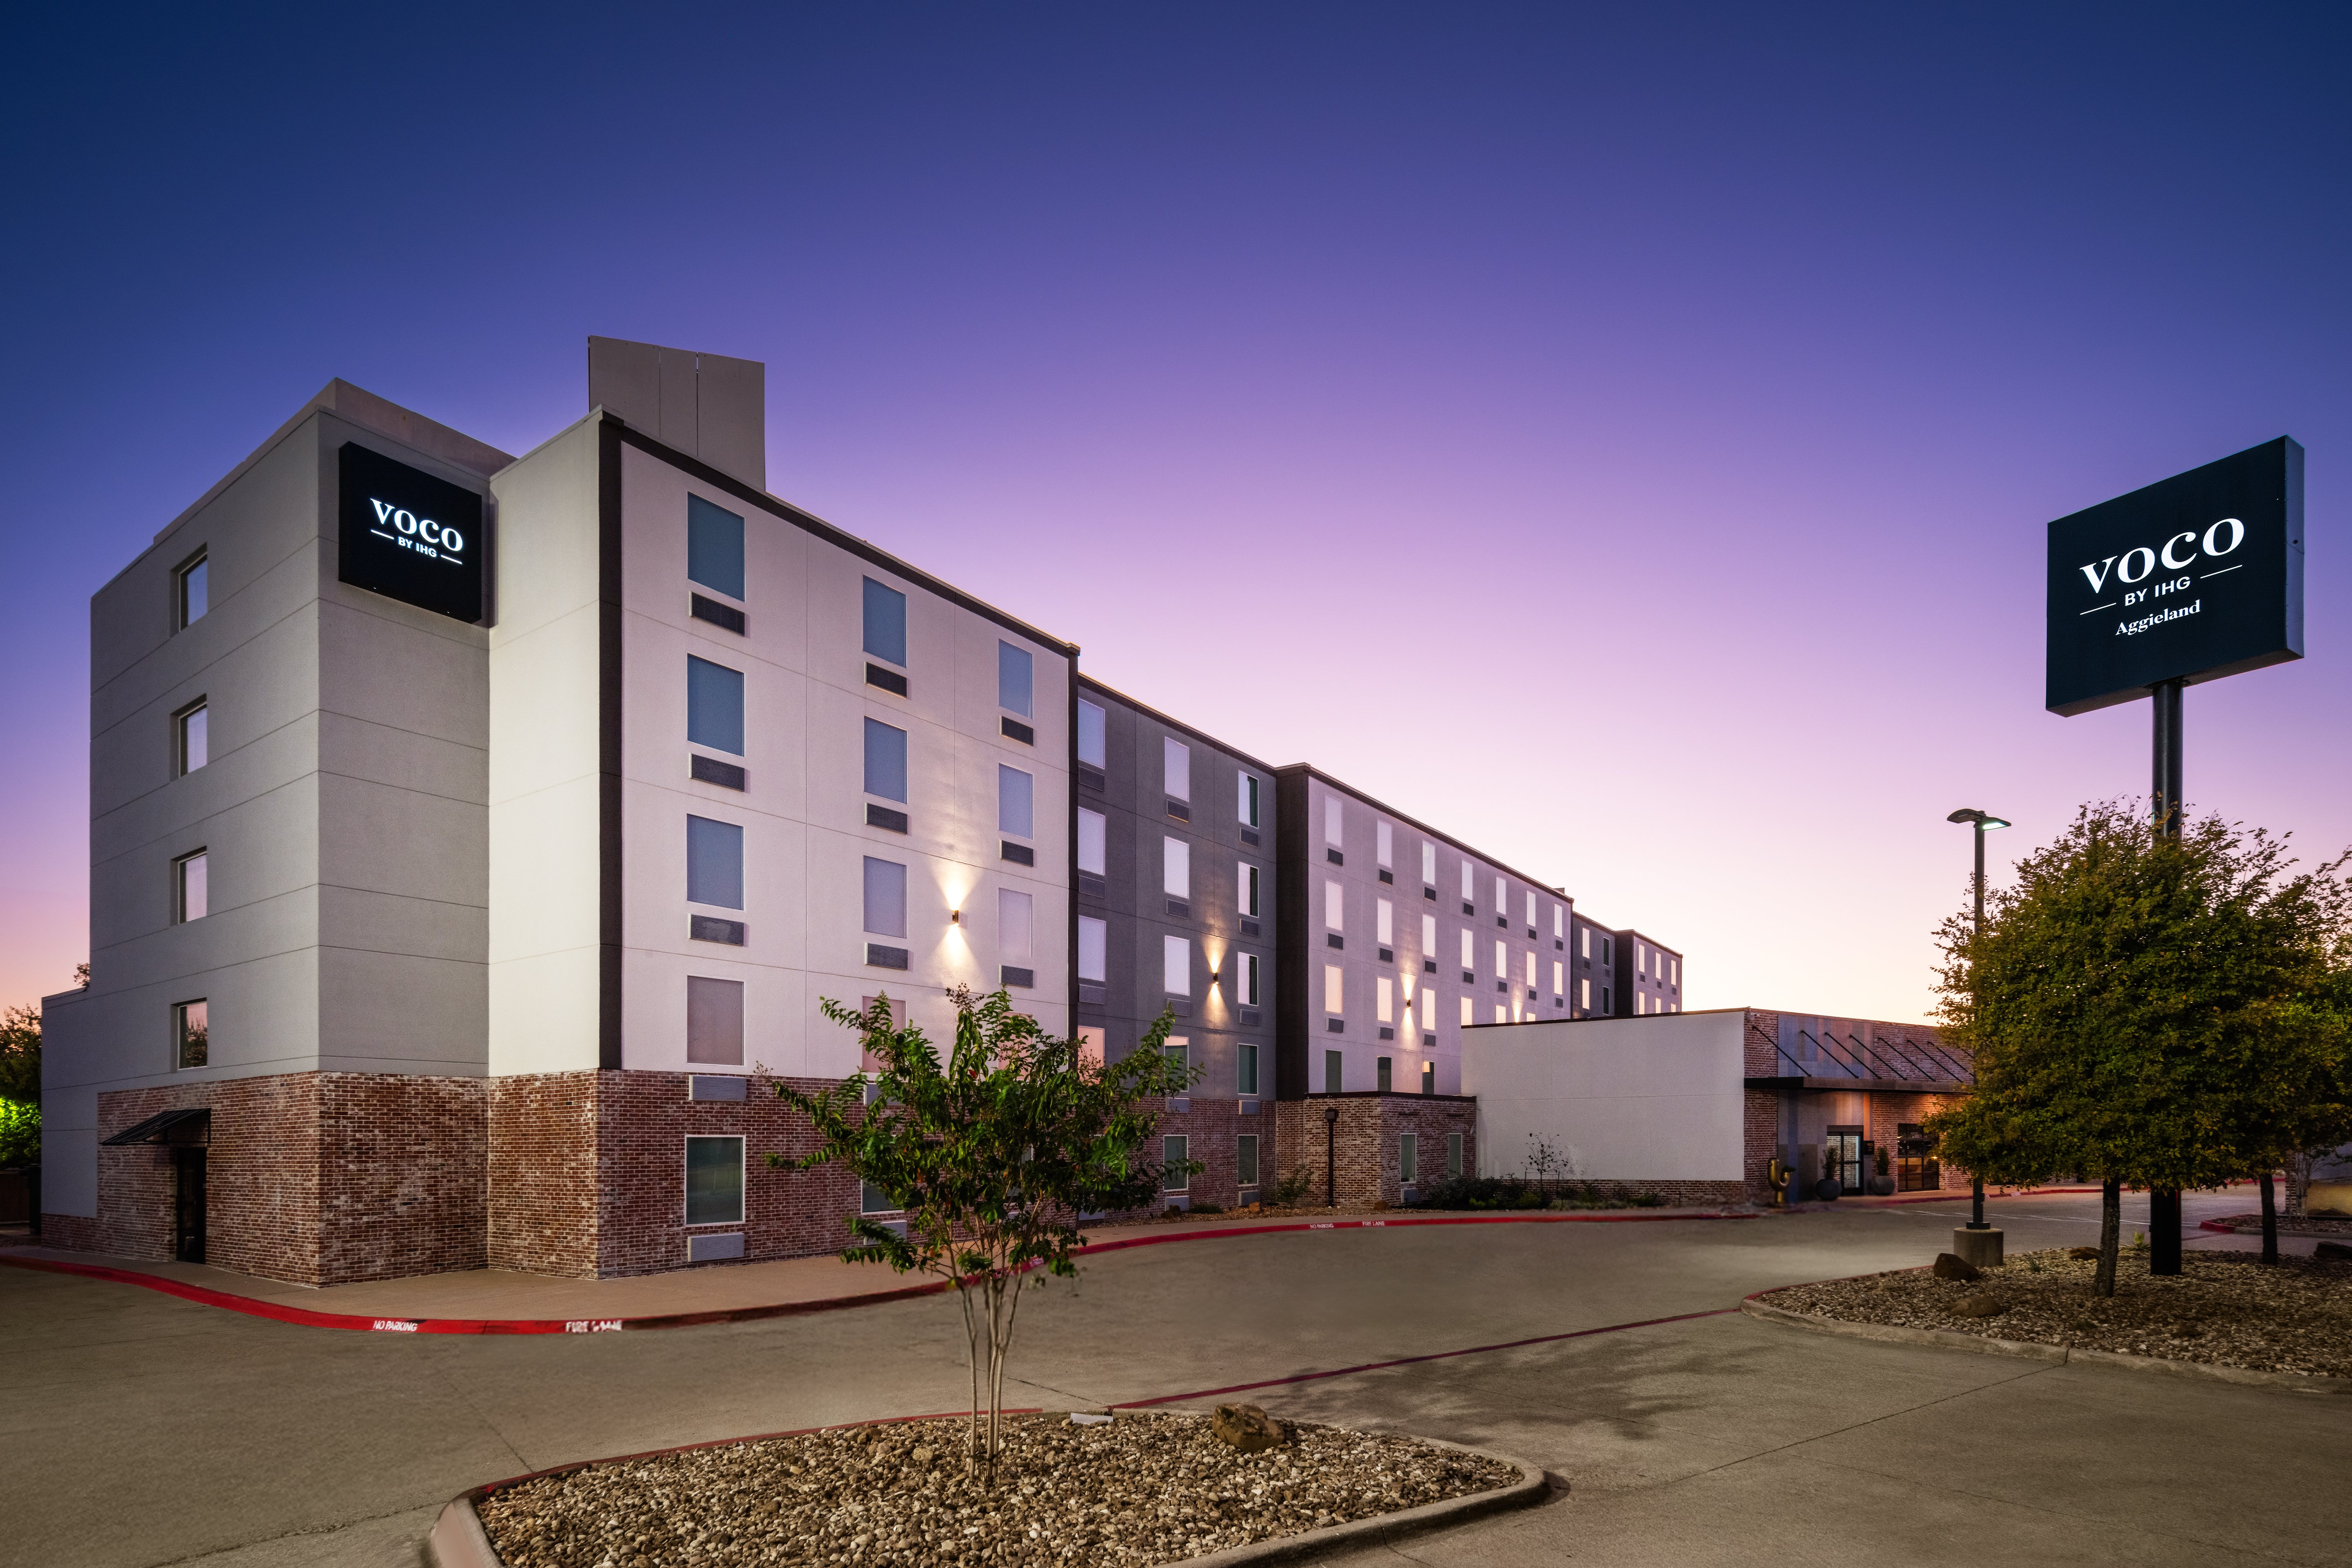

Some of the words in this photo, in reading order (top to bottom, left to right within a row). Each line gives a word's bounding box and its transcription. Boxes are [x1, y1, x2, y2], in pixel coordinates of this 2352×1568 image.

[398, 536, 413, 549] BY
[416, 543, 437, 557] IHG
[2125, 588, 2148, 606] BY
[2155, 576, 2190, 597] IHG
[2115, 599, 2201, 635] Aggieland
[373, 1320, 385, 1330] NO
[385, 1321, 418, 1331] PARKING
